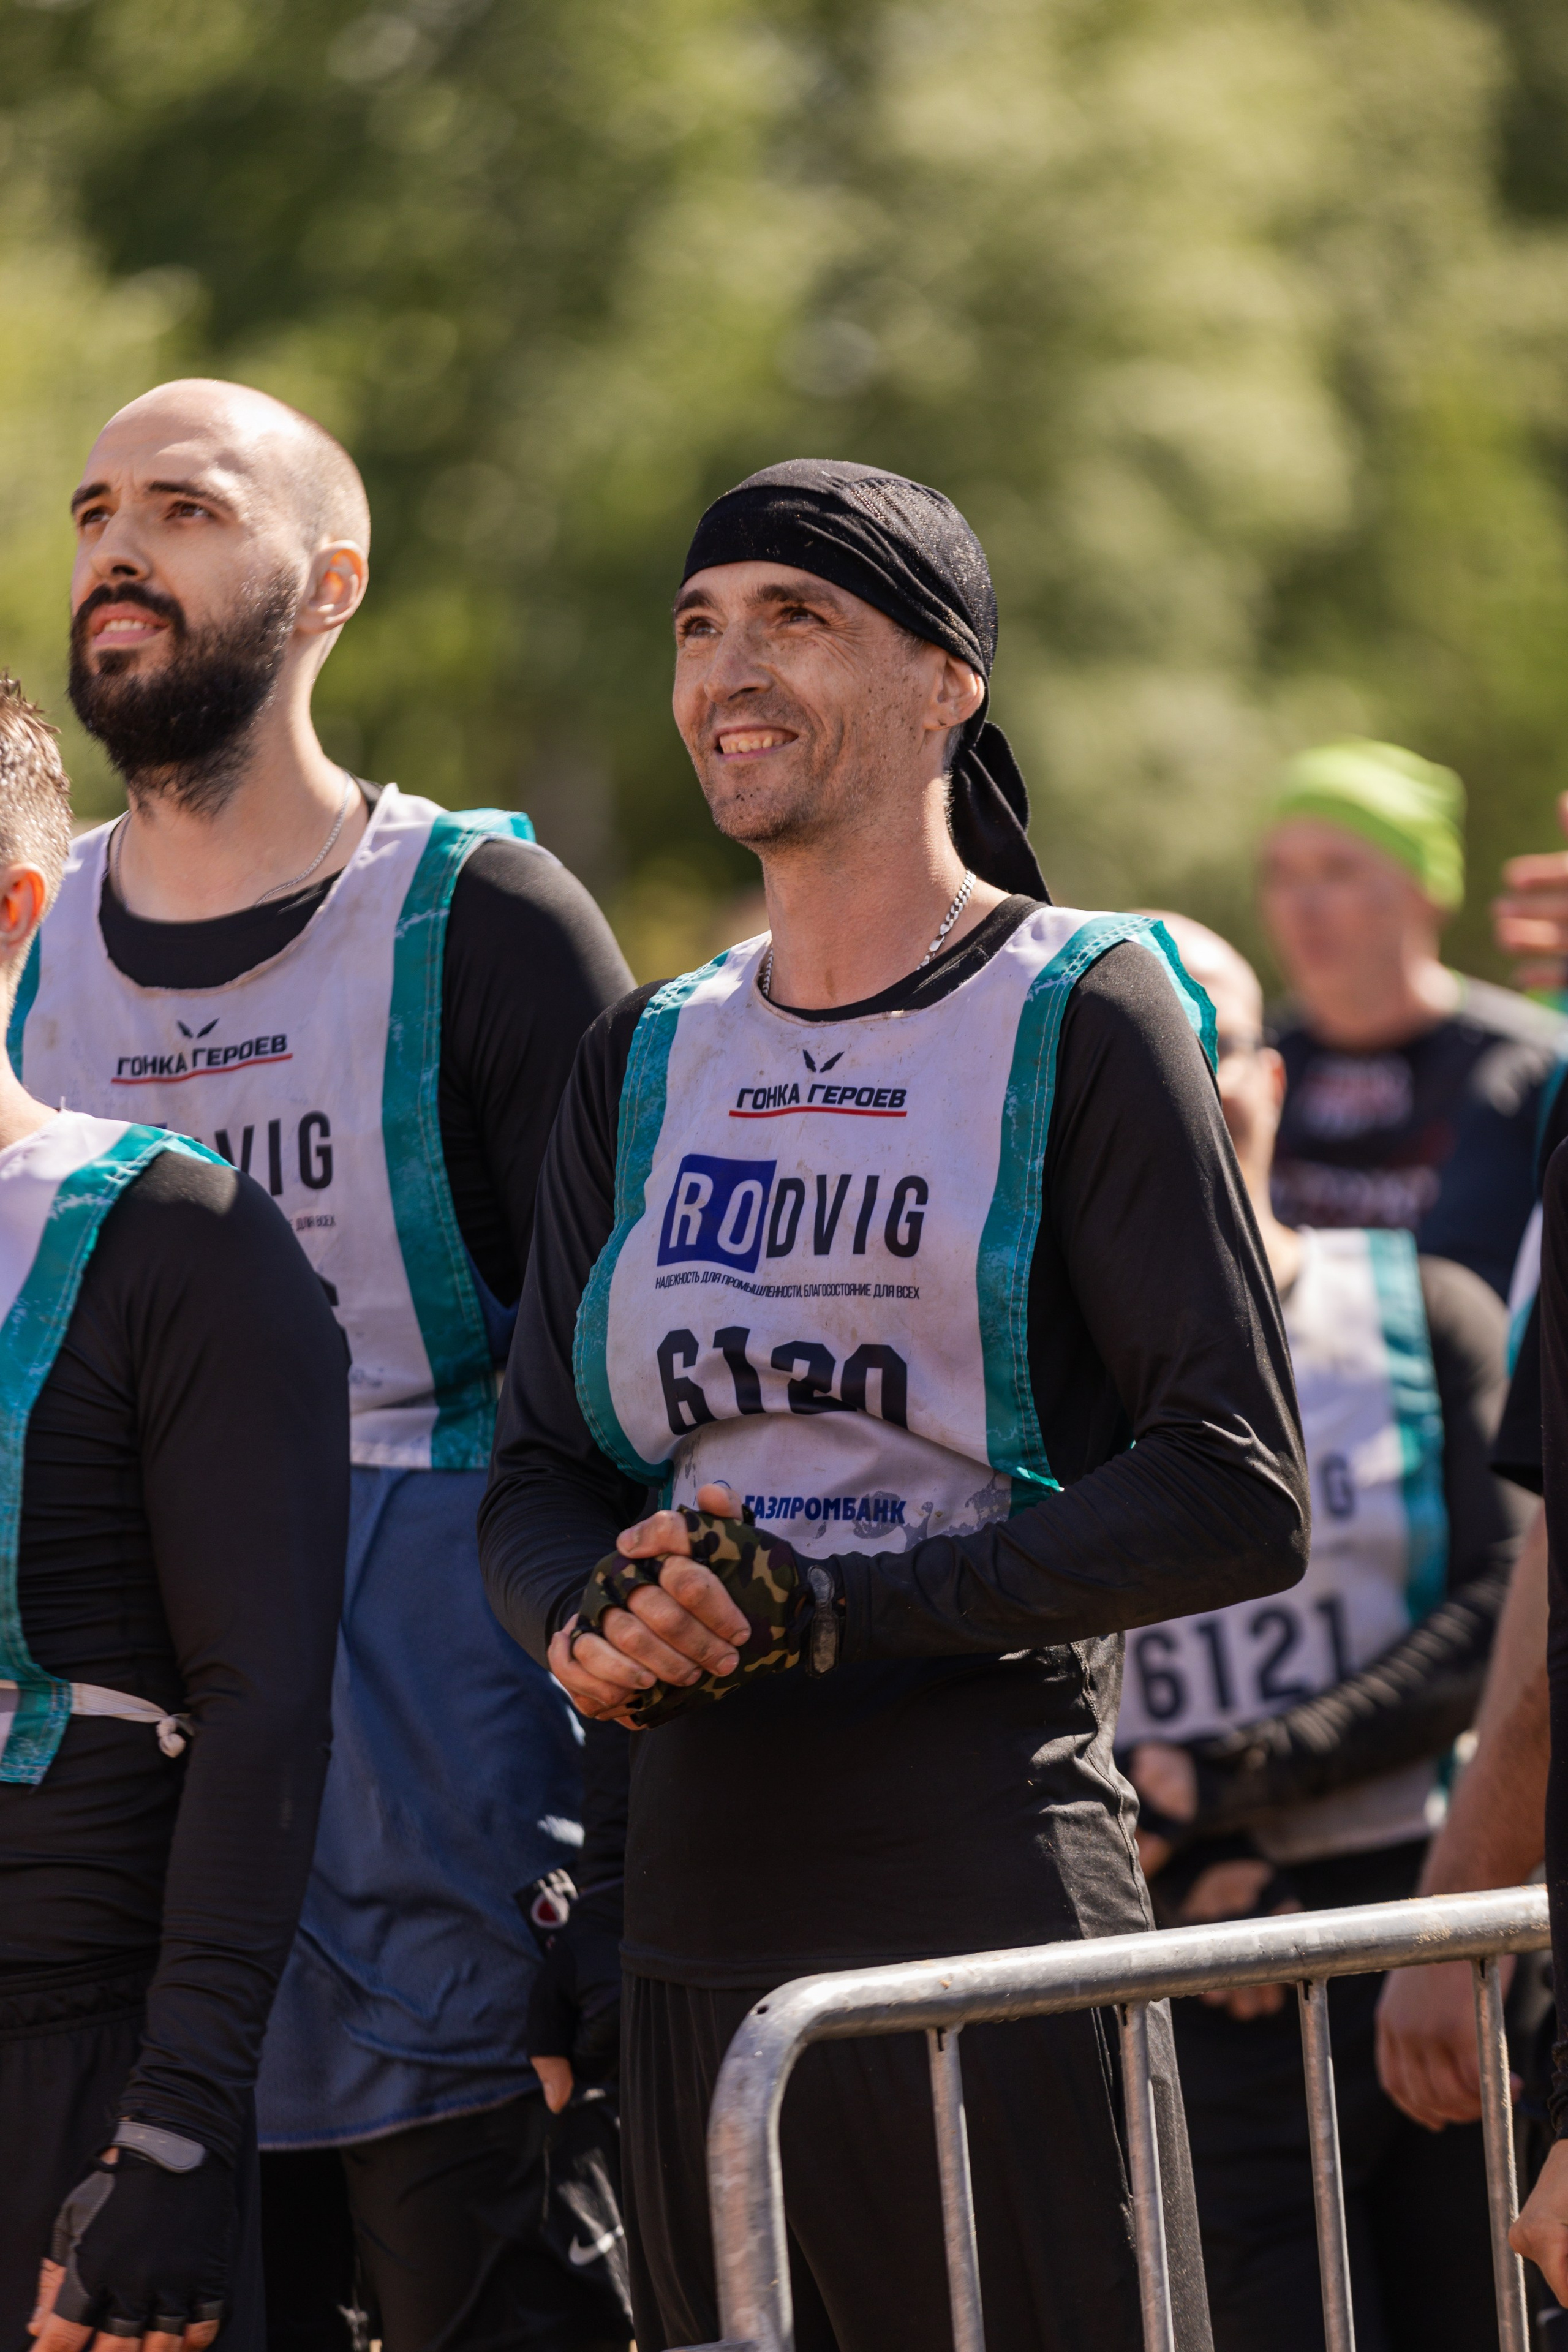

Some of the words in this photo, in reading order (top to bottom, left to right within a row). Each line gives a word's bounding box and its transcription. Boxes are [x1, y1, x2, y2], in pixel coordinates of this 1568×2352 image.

[116, 1051, 187, 1076] ГОНКА
[192, 1033, 288, 1068] ГЕРОЕВ
[736, 1082, 800, 1110] ГОНКА
[807, 1084, 908, 1109] ГЕРОЕВ
[669, 1171, 929, 1259] RODVIG
[655, 1270, 700, 1289] НАДЕЖНОСТЬ
[700, 1271, 722, 1284] ДЛЯ
[721, 1274, 803, 1298] ПРОМЫШЛЕННОСТИ,
[804, 1283, 872, 1298] БЛАГОСОСТОЯНИЕ
[873, 1284, 894, 1299] ДЛЯ
[896, 1285, 920, 1300] ВСЕХ
[657, 1325, 910, 1436] 6120
[745, 1495, 907, 1525] ГАЗПРОМБАНК
[1134, 1591, 1351, 1722] 6121
